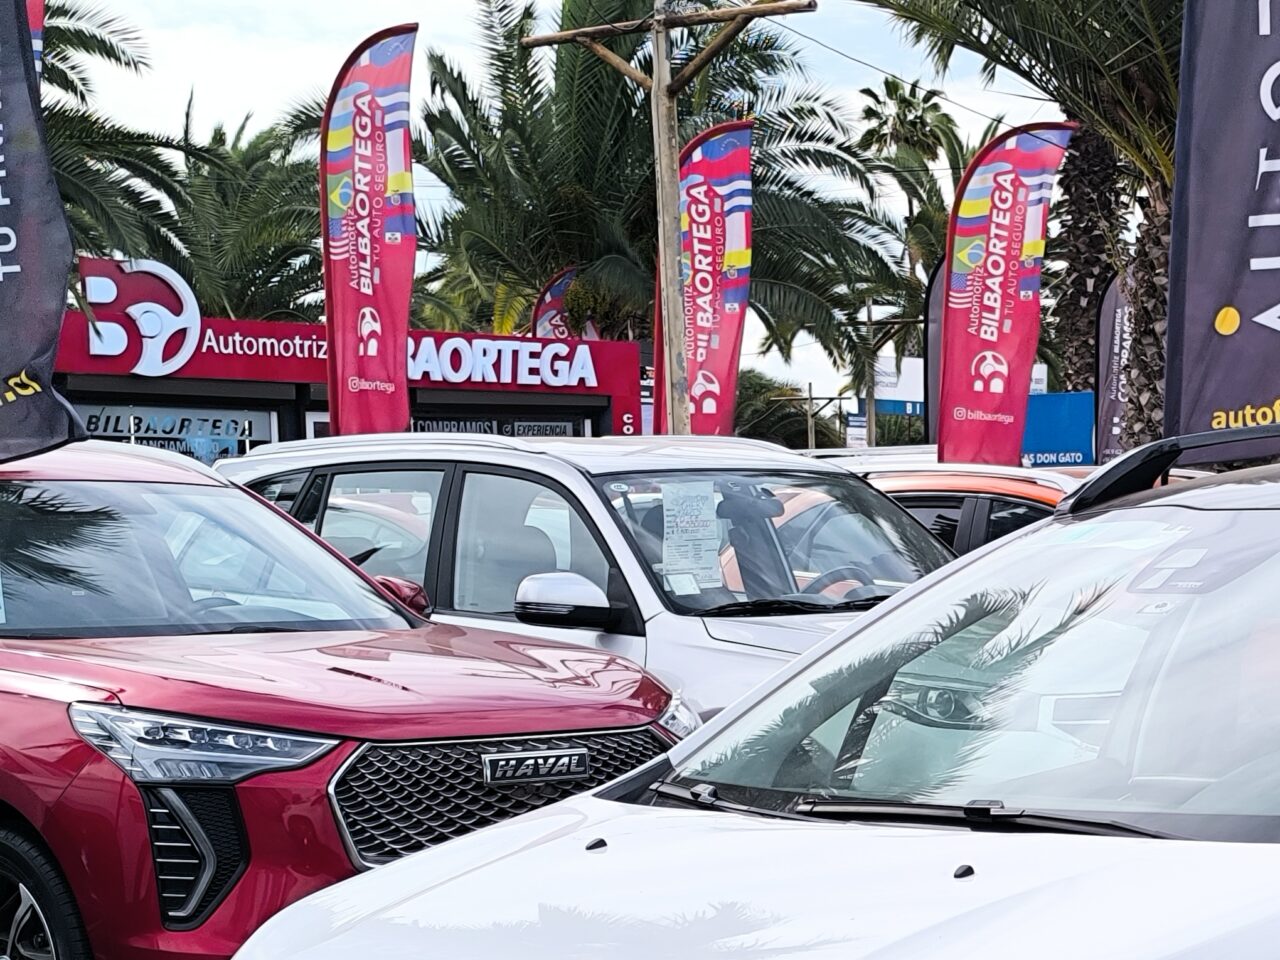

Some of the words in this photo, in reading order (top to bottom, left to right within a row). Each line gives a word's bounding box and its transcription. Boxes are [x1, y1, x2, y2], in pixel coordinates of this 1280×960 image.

[374, 131, 386, 191] SEGURO
[355, 94, 373, 296] BILBAORTEGA
[372, 197, 383, 240] AUTO
[1012, 205, 1025, 255] SEGURO
[347, 207, 360, 290] Automotriz
[372, 244, 380, 262] TU
[714, 217, 723, 270] SEGURO
[980, 172, 1016, 342] BILBAORTEGA
[1006, 258, 1019, 296] AUTO
[967, 265, 985, 335] Automotriz
[1004, 299, 1015, 316] TU
[201, 328, 328, 360] Automotriz
[86, 414, 254, 438] BILBAORTEGA
[516, 424, 568, 436] EXPERIENCIA
[1036, 452, 1057, 464] DON
[1058, 452, 1083, 463] GATO
[495, 755, 585, 778] HAVAL
